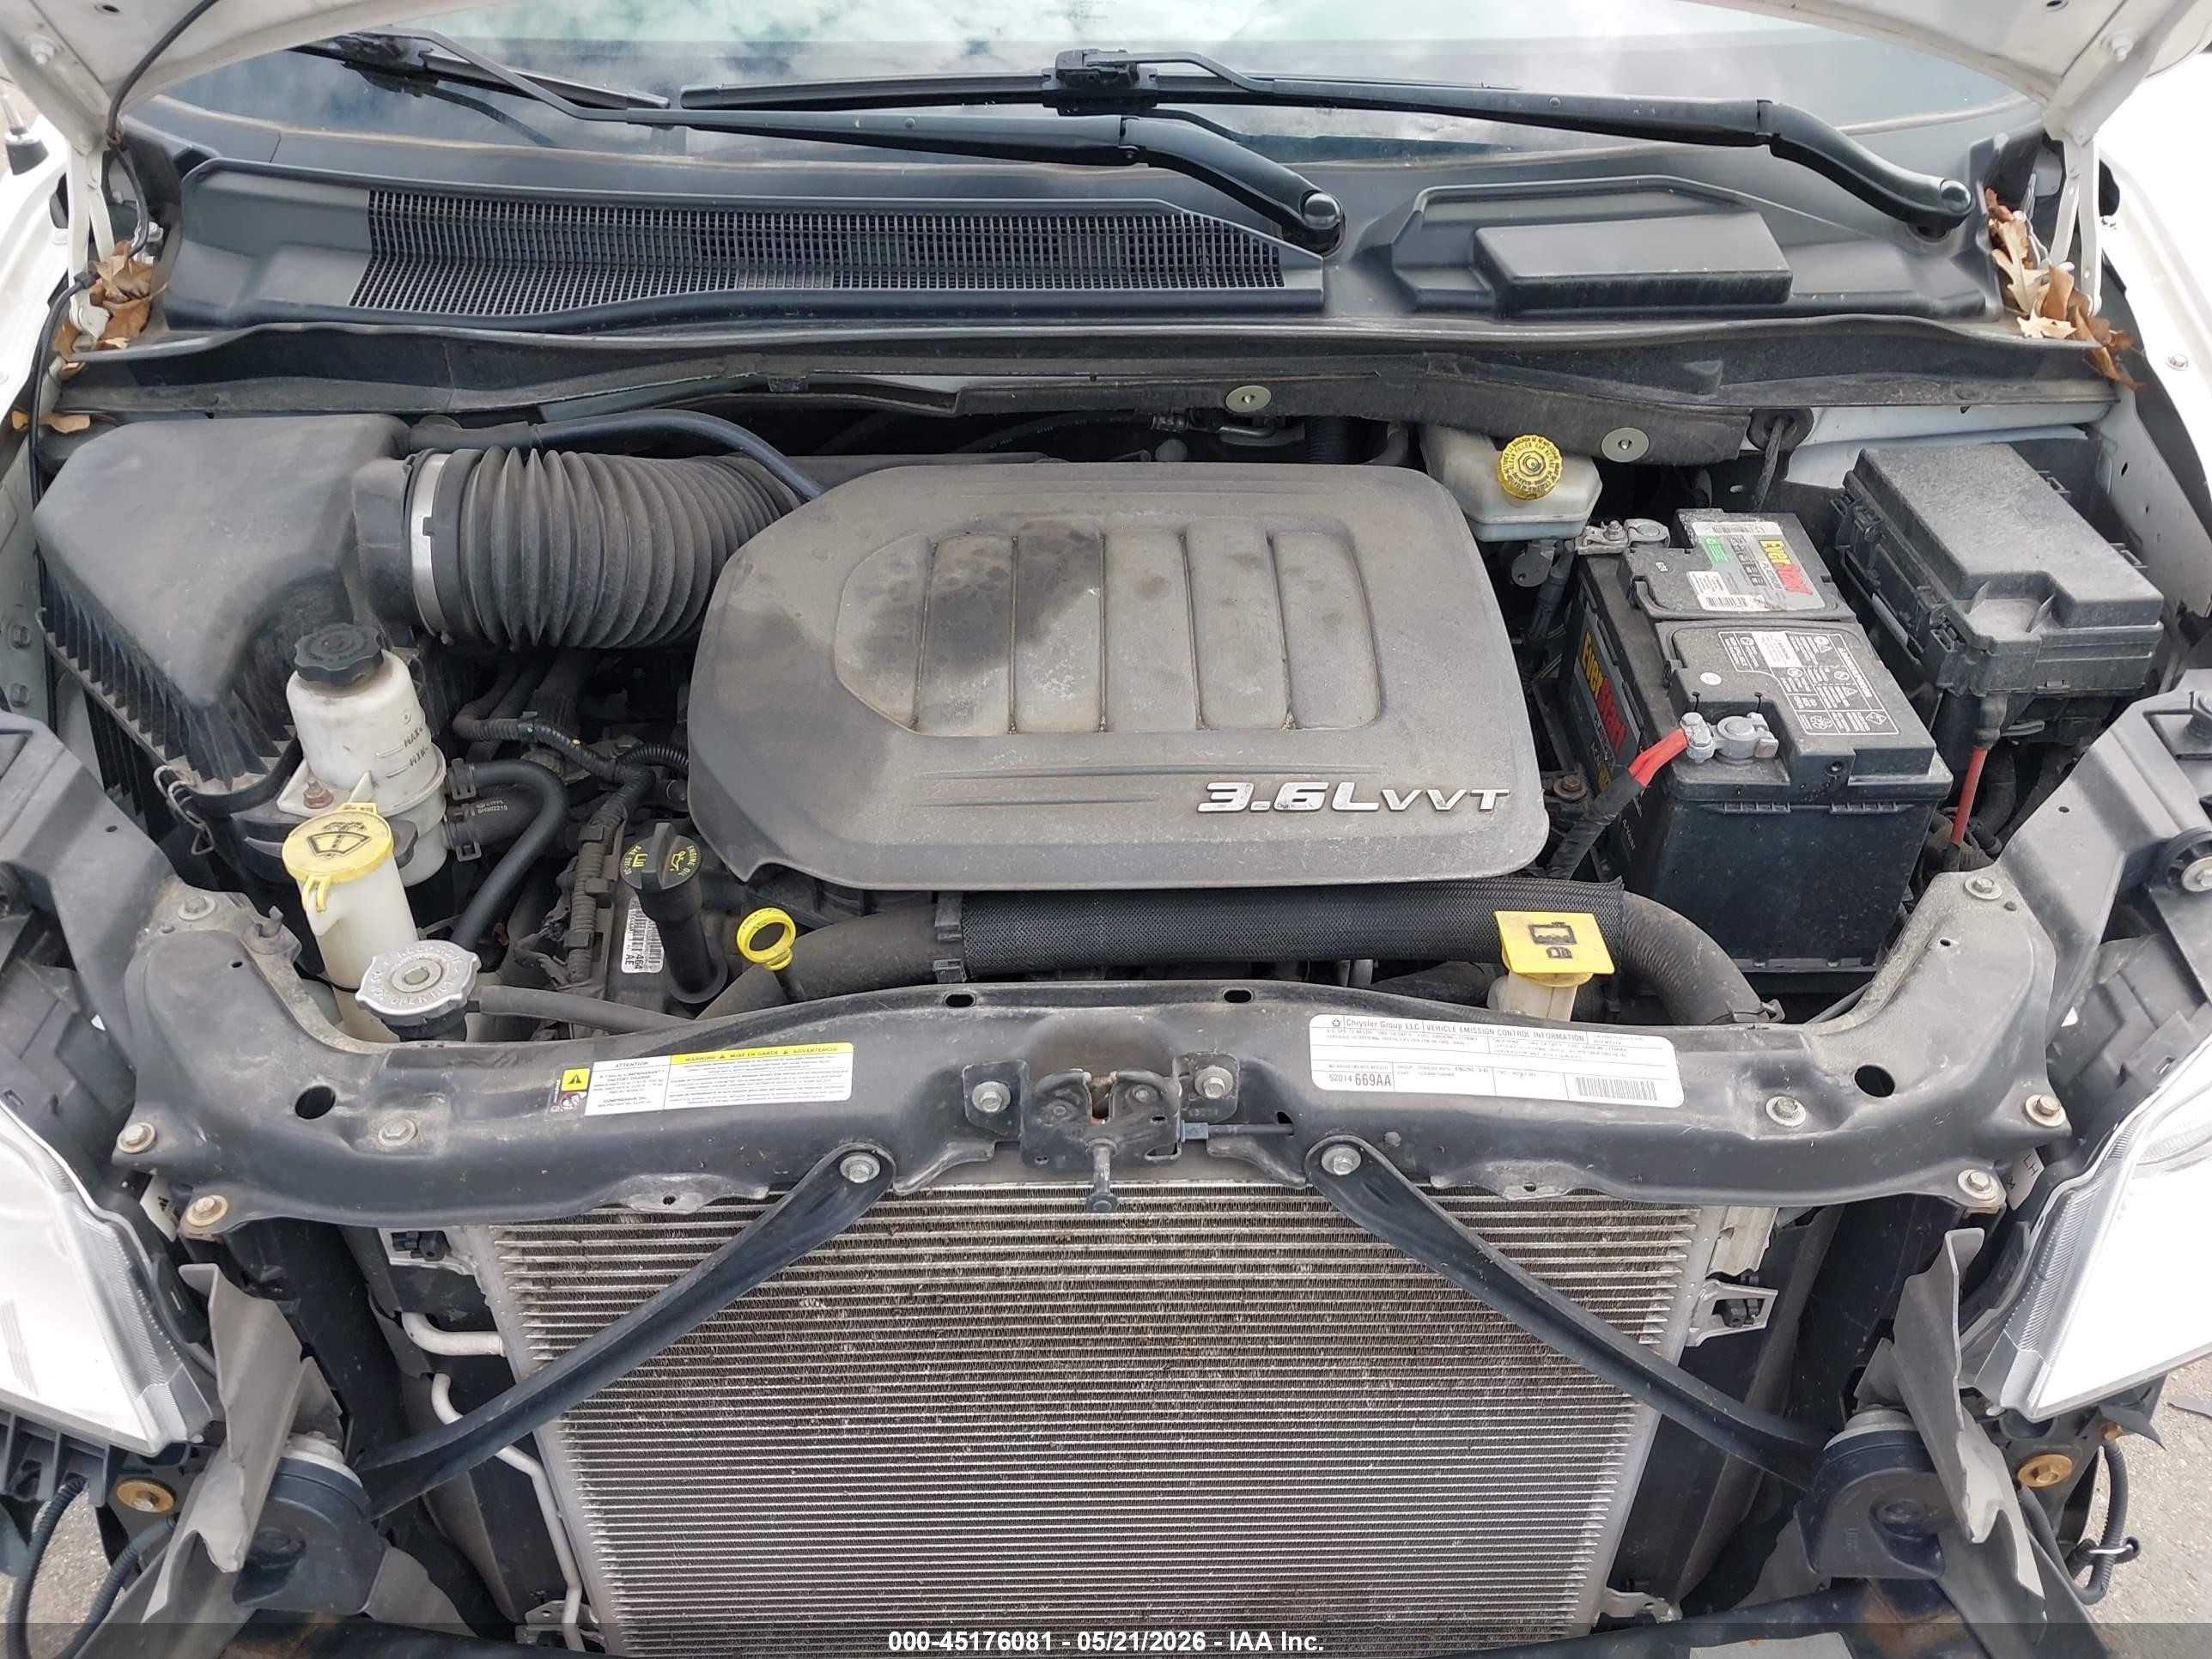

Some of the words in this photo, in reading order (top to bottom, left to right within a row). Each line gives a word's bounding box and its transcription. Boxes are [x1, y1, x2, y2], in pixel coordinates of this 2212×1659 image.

[687, 845, 697, 866] ENGINE
[678, 867, 690, 877] OIL
[624, 954, 635, 966] AE
[635, 954, 645, 970] 464
[1346, 1018, 1377, 1029] Chrysler
[1380, 1020, 1403, 1030] Group
[1406, 1021, 1420, 1030] LLC
[1426, 1024, 1456, 1033] VEHICLE
[1460, 1026, 1495, 1036] EMISSION
[1497, 1029, 1530, 1038] CONTROL
[1533, 1031, 1584, 1042] INFORMATION
[1328, 1073, 1353, 1082] 52014
[1355, 1073, 1392, 1087] 669AA
[2024, 1154, 2039, 1176] LH
